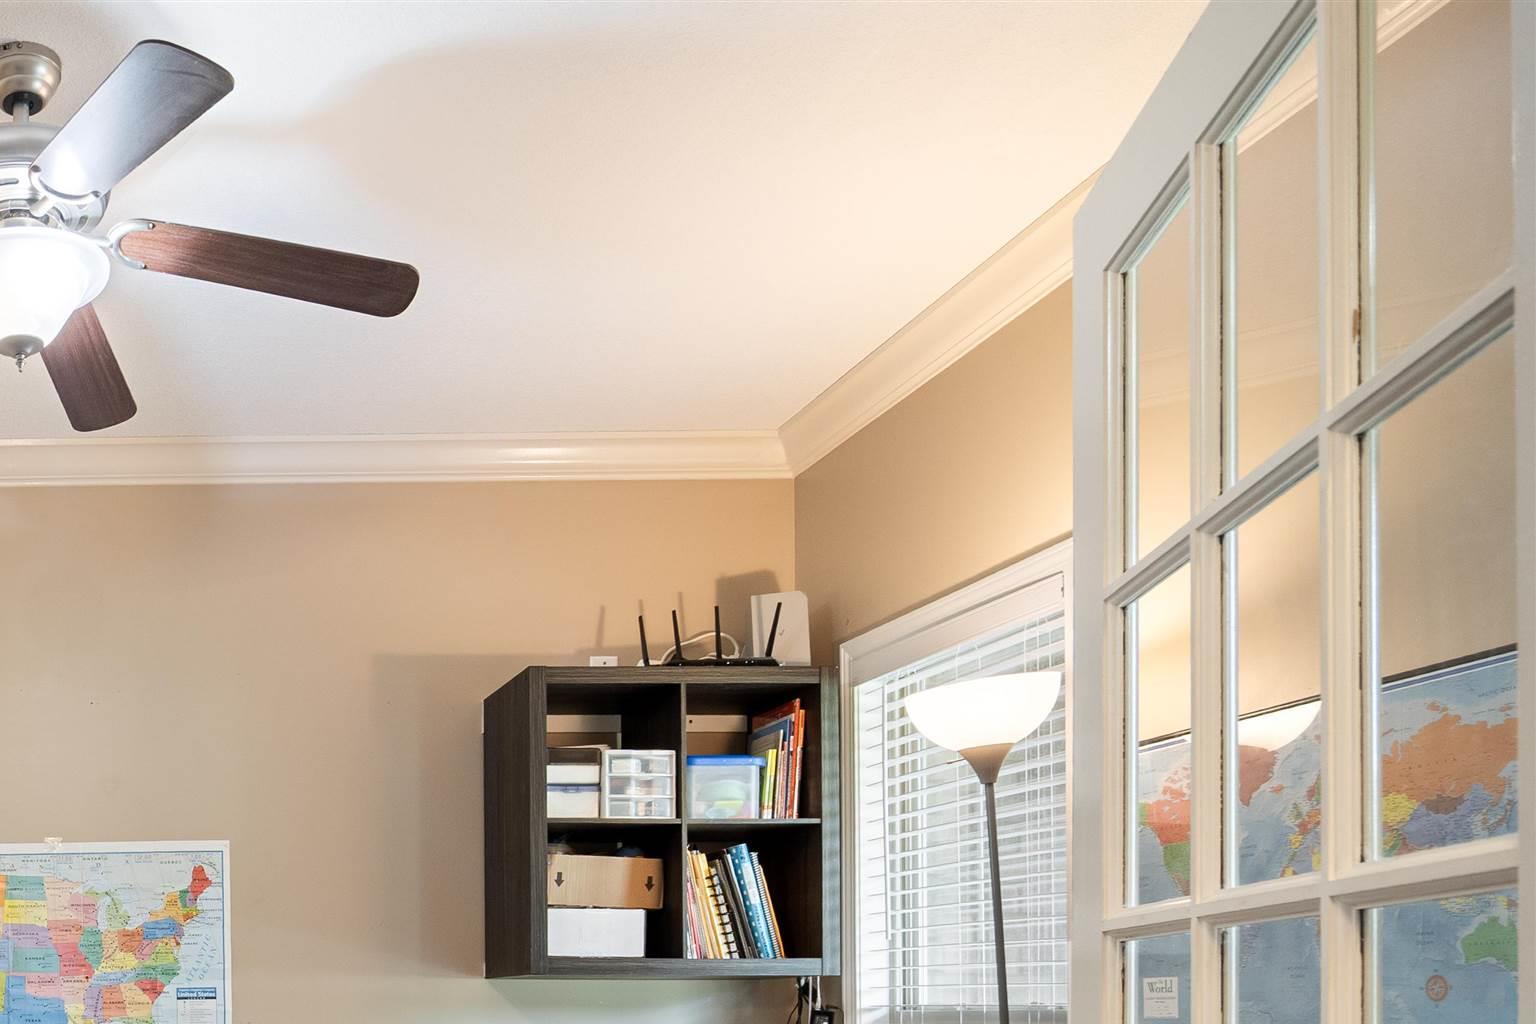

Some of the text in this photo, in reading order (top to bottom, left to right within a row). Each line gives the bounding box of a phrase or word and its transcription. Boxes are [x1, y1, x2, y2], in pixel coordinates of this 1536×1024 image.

[1146, 979, 1173, 993] World
[177, 989, 197, 998] United
[197, 989, 216, 998] States
